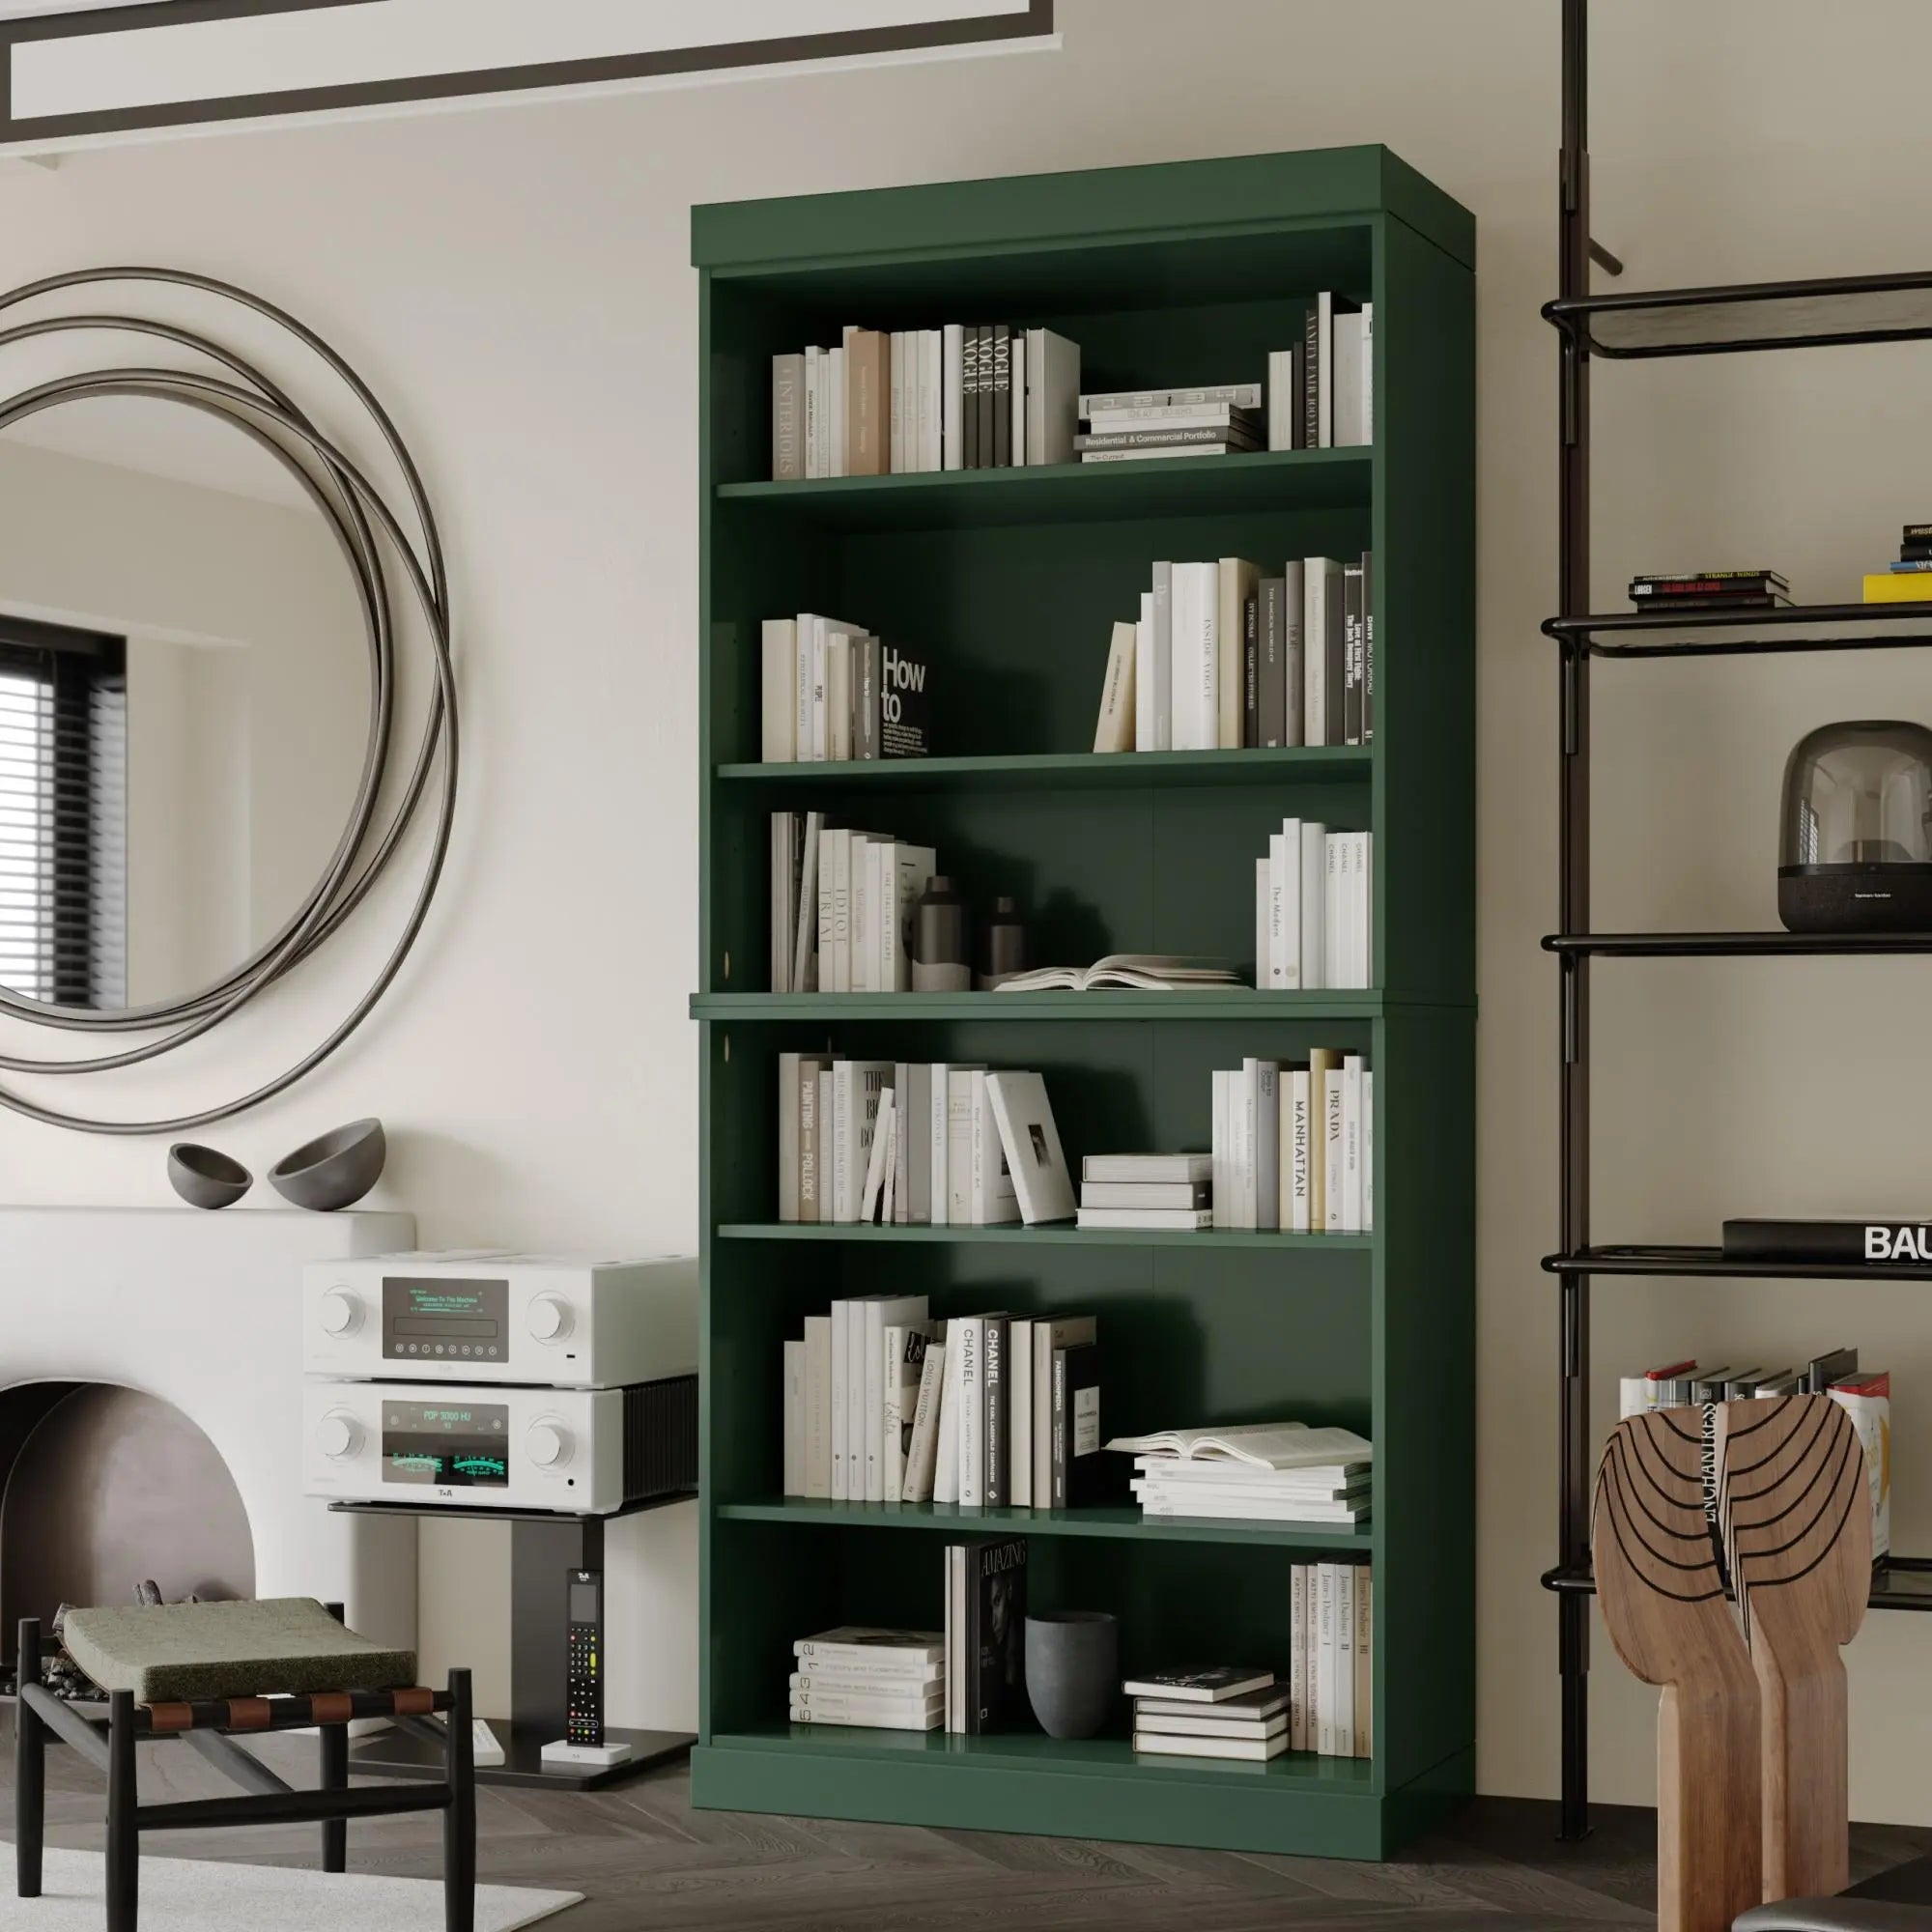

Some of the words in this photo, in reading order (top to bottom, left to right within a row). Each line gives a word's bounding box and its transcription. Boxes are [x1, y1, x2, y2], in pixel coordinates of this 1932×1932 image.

[963, 338, 978, 394] VOGUE
[979, 336, 994, 393] VOGUE
[994, 334, 1009, 391] VOGUE
[779, 380, 794, 473] INTERIORS
[1085, 436, 1126, 446] Residential
[1136, 432, 1182, 443] Commercial
[1183, 430, 1217, 440] Portfolio
[883, 645, 925, 694] How
[881, 684, 901, 724] to
[1272, 887, 1282, 901] The
[1272, 904, 1282, 938] Modern
[803, 1081, 814, 1129] PAINTING
[1329, 1090, 1340, 1142] PRADA
[1295, 1100, 1305, 1198] MANHATTAN
[803, 1152, 814, 1200] POLLOCK
[924, 1359, 935, 1394] LOUIS
[963, 1328, 974, 1387] CHANEL
[987, 1328, 999, 1388] CHANEL
[918, 1394, 932, 1428] VUITTON
[980, 1539, 1026, 1577] AMAZING
[803, 1644, 814, 1656] 2
[799, 1693, 810, 1705] 4
[801, 1677, 810, 1689] 3
[800, 1709, 811, 1721] 5
